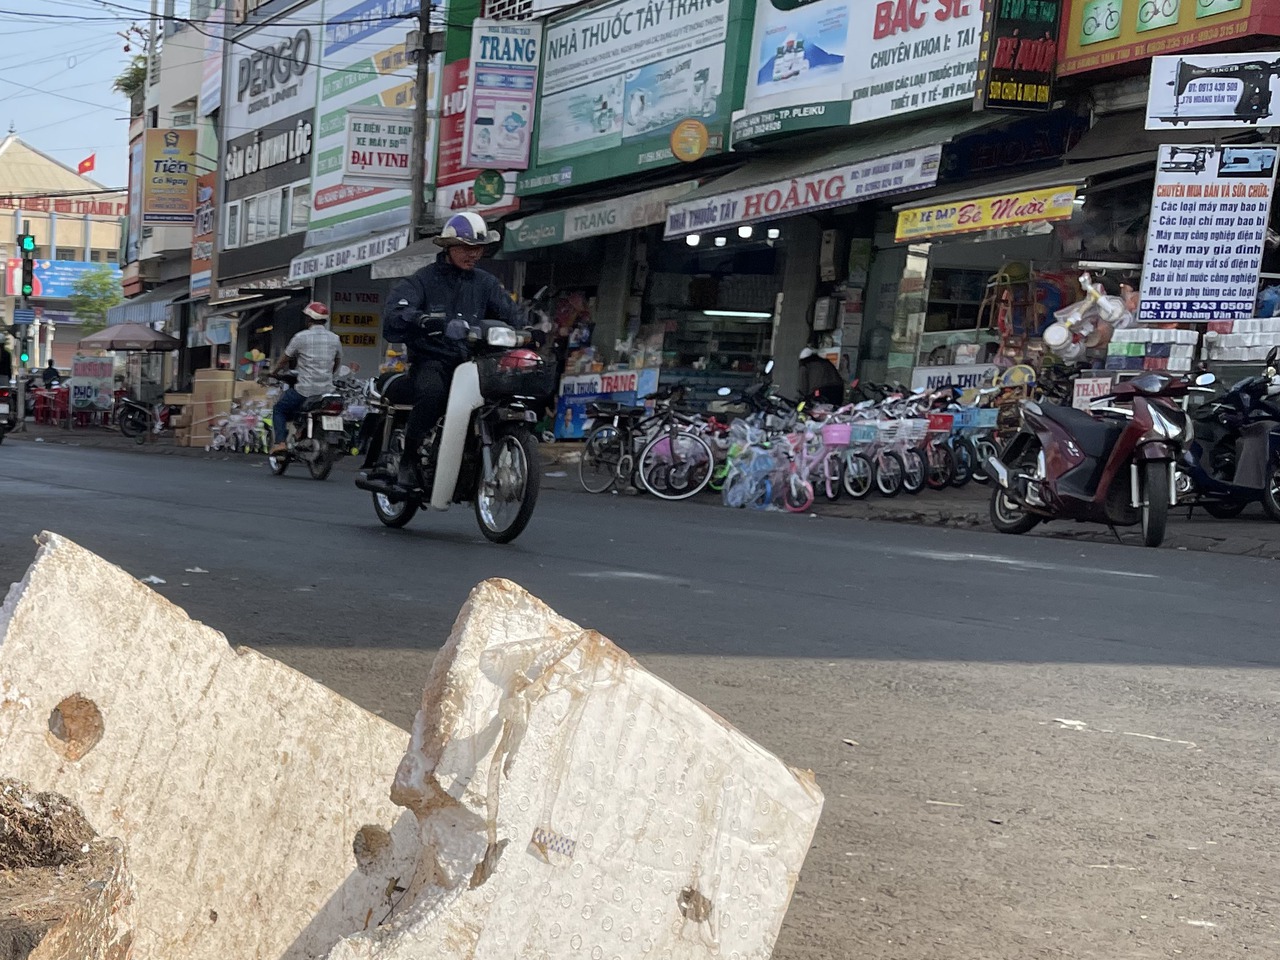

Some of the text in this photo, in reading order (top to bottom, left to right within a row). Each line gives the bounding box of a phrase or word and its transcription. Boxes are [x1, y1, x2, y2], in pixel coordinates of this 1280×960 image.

[548, 28, 578, 61] NHÀ
[582, 8, 633, 50] THUỐC
[480, 35, 536, 63] TRANG
[871, 41, 911, 69] CHUYÊN
[913, 36, 941, 59] KHOA
[957, 27, 975, 48] TAI
[237, 28, 311, 103] PERGO
[792, 105, 825, 118] PLEIKU
[353, 122, 362, 132] XE
[388, 125, 396, 134] XE
[288, 119, 312, 164] LỘC
[356, 135, 387, 148] XE MÁY
[351, 150, 373, 170] ĐẠI
[377, 152, 409, 168] VINH
[741, 175, 846, 218] HOÀNG
[1157, 183, 1185, 198] CHUYÊN
[1186, 184, 1202, 198] MUA
[1204, 182, 1219, 198] BÁN
[920, 209, 934, 223] XE
[957, 204, 982, 225] Bé
[991, 197, 1048, 220] Mười
[1161, 201, 1178, 212] Các
[1180, 201, 1196, 214] loại
[1199, 201, 1217, 213] máy
[1219, 203, 1238, 213] may
[1240, 202, 1257, 212] bao
[574, 208, 617, 232] TRANG
[1159, 215, 1176, 226] Các
[1179, 215, 1196, 228] loại
[1215, 217, 1236, 227] may
[1237, 216, 1254, 226] bao
[1156, 230, 1172, 241] Máy
[1173, 231, 1189, 240] may
[1190, 229, 1209, 241] công
[1210, 230, 1235, 242] nghiệp
[1157, 244, 1182, 255] Máy
[1185, 245, 1210, 255] may
[1213, 244, 1231, 256] gia
[1152, 258, 1168, 268] Các
[1170, 258, 1185, 270] loại
[1187, 259, 1203, 269] máy
[1230, 272, 1257, 285] nghiệp
[1222, 287, 1236, 296] các
[1238, 287, 1254, 299] loại
[1164, 301, 1188, 310] 091
[1192, 302, 1217, 310] 343
[1220, 302, 1253, 310] 0509
[338, 313, 351, 325] XE
[601, 374, 636, 393] TRANG
